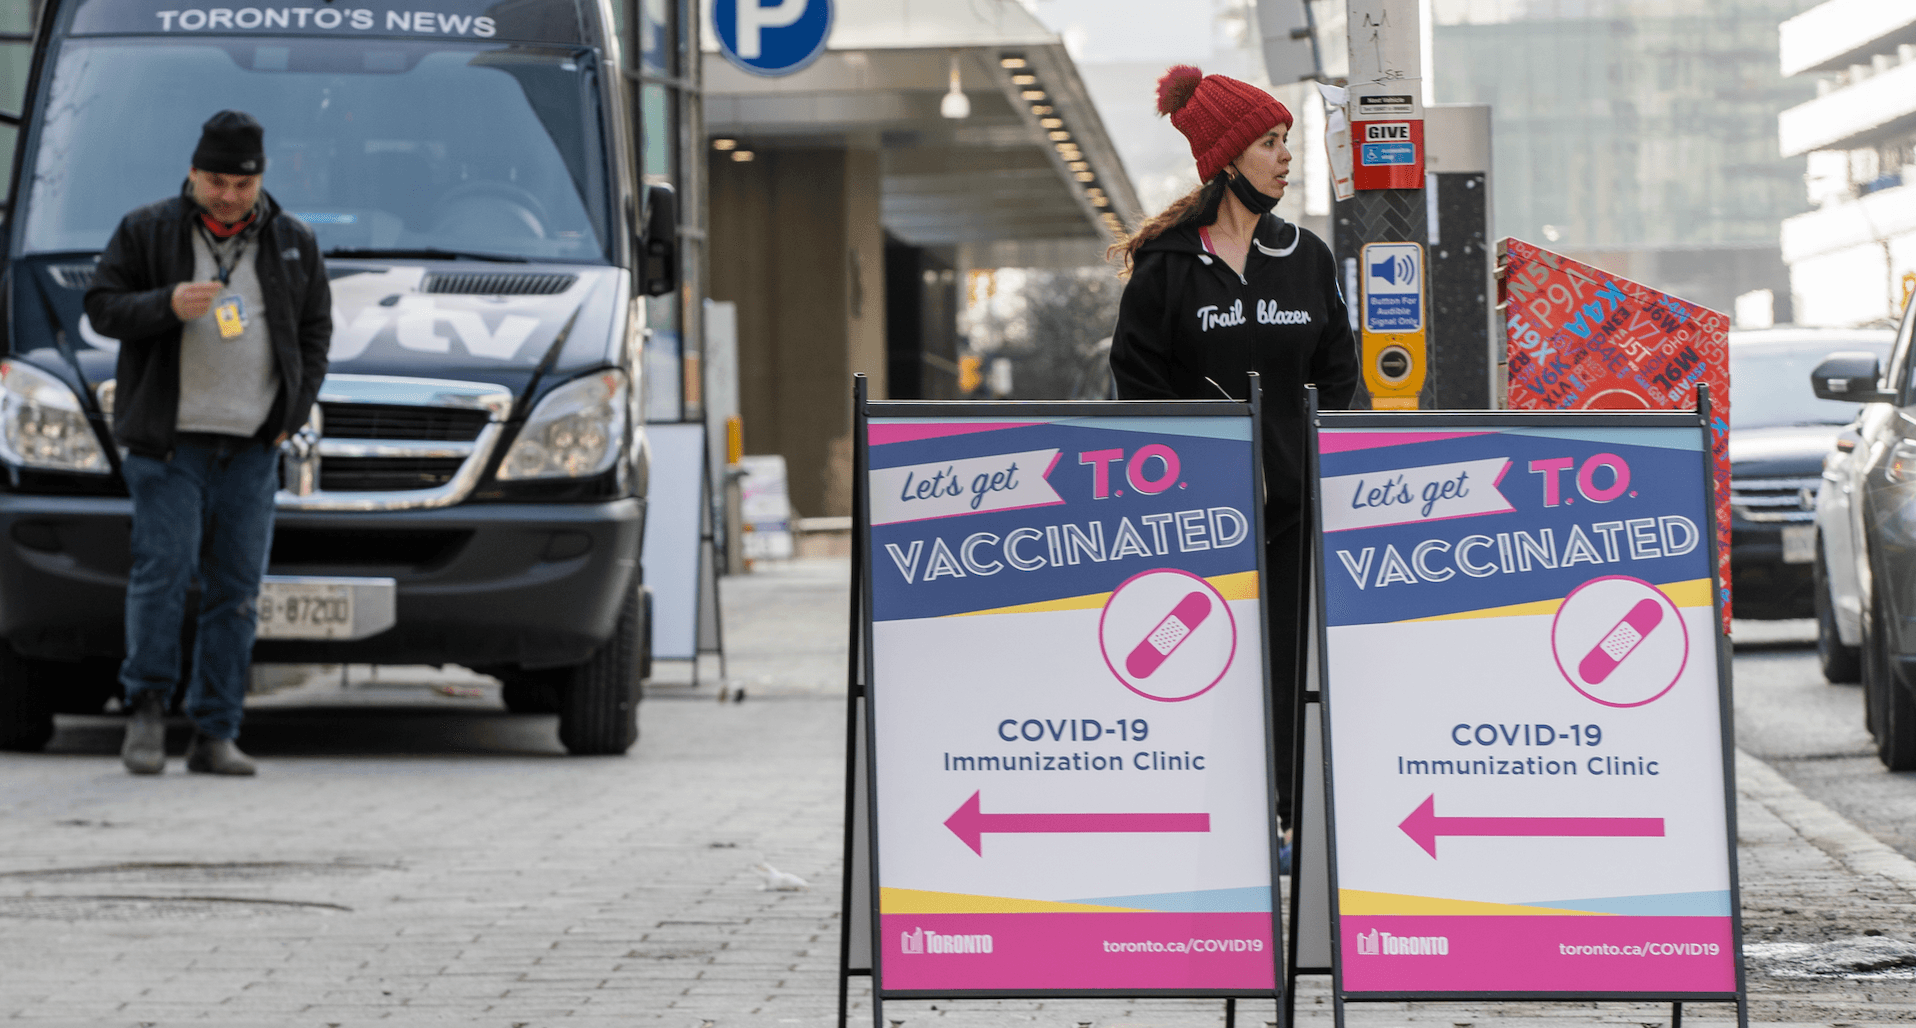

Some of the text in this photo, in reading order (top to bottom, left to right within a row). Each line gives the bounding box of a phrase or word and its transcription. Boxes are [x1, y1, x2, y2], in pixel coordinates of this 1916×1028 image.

[156, 7, 497, 37] TORONTO'S NEWS
[736, 0, 809, 59] P
[1369, 126, 1408, 139] GIVE
[1197, 299, 1246, 332] Trail
[1529, 267, 1598, 329] P9A
[1563, 280, 1627, 338] K4A
[1508, 314, 1556, 365] H9X
[1629, 310, 1668, 352] V7J
[1618, 336, 1653, 363] J5T
[1527, 356, 1571, 395] V6K
[901, 443, 1187, 510] Let's get T.O.
[1352, 452, 1638, 517] Let's get T.O.
[885, 506, 1249, 584] VACCINATED
[1336, 515, 1700, 590] VACCINATED
[998, 718, 1149, 742] COVID-19
[1451, 723, 1602, 747] COVID-19
[944, 750, 1206, 771] Immunization Clinic
[1398, 755, 1660, 776] Immunization Clinic
[924, 930, 1263, 954] TORONTO toronto.ca/COVID19
[1380, 932, 1720, 958] TORONTO toronto.ca/COVID19
